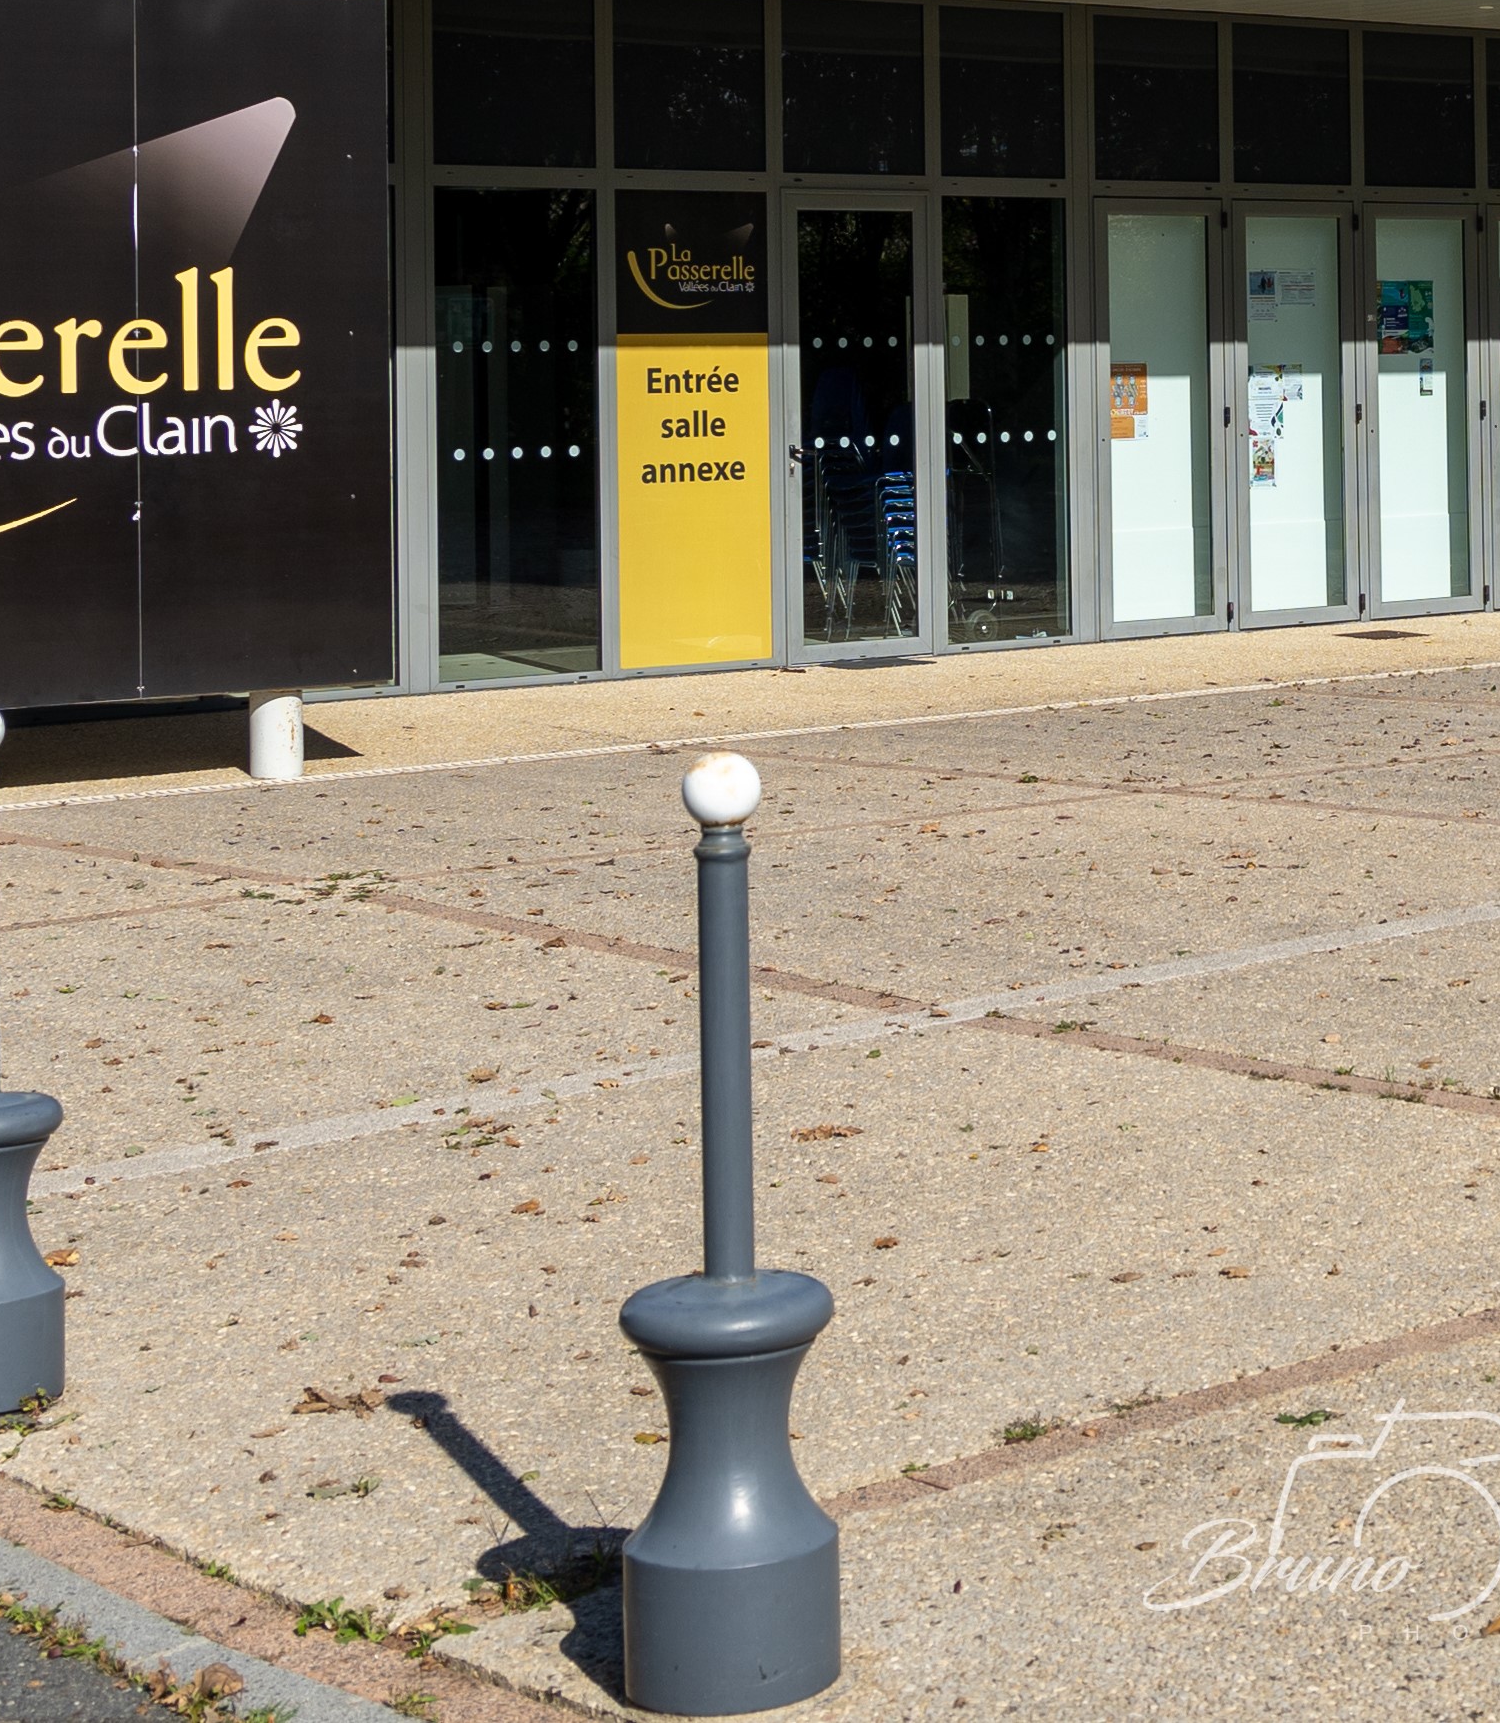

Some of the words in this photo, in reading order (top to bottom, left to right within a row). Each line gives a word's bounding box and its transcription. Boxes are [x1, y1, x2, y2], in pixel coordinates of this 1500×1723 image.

[647, 248, 755, 281] Passerelle
[670, 243, 692, 262] La
[646, 364, 740, 394] Entrée
[46, 425, 92, 459] du
[95, 404, 238, 457] Clain
[660, 409, 726, 439] salle
[641, 456, 746, 484] annexe
